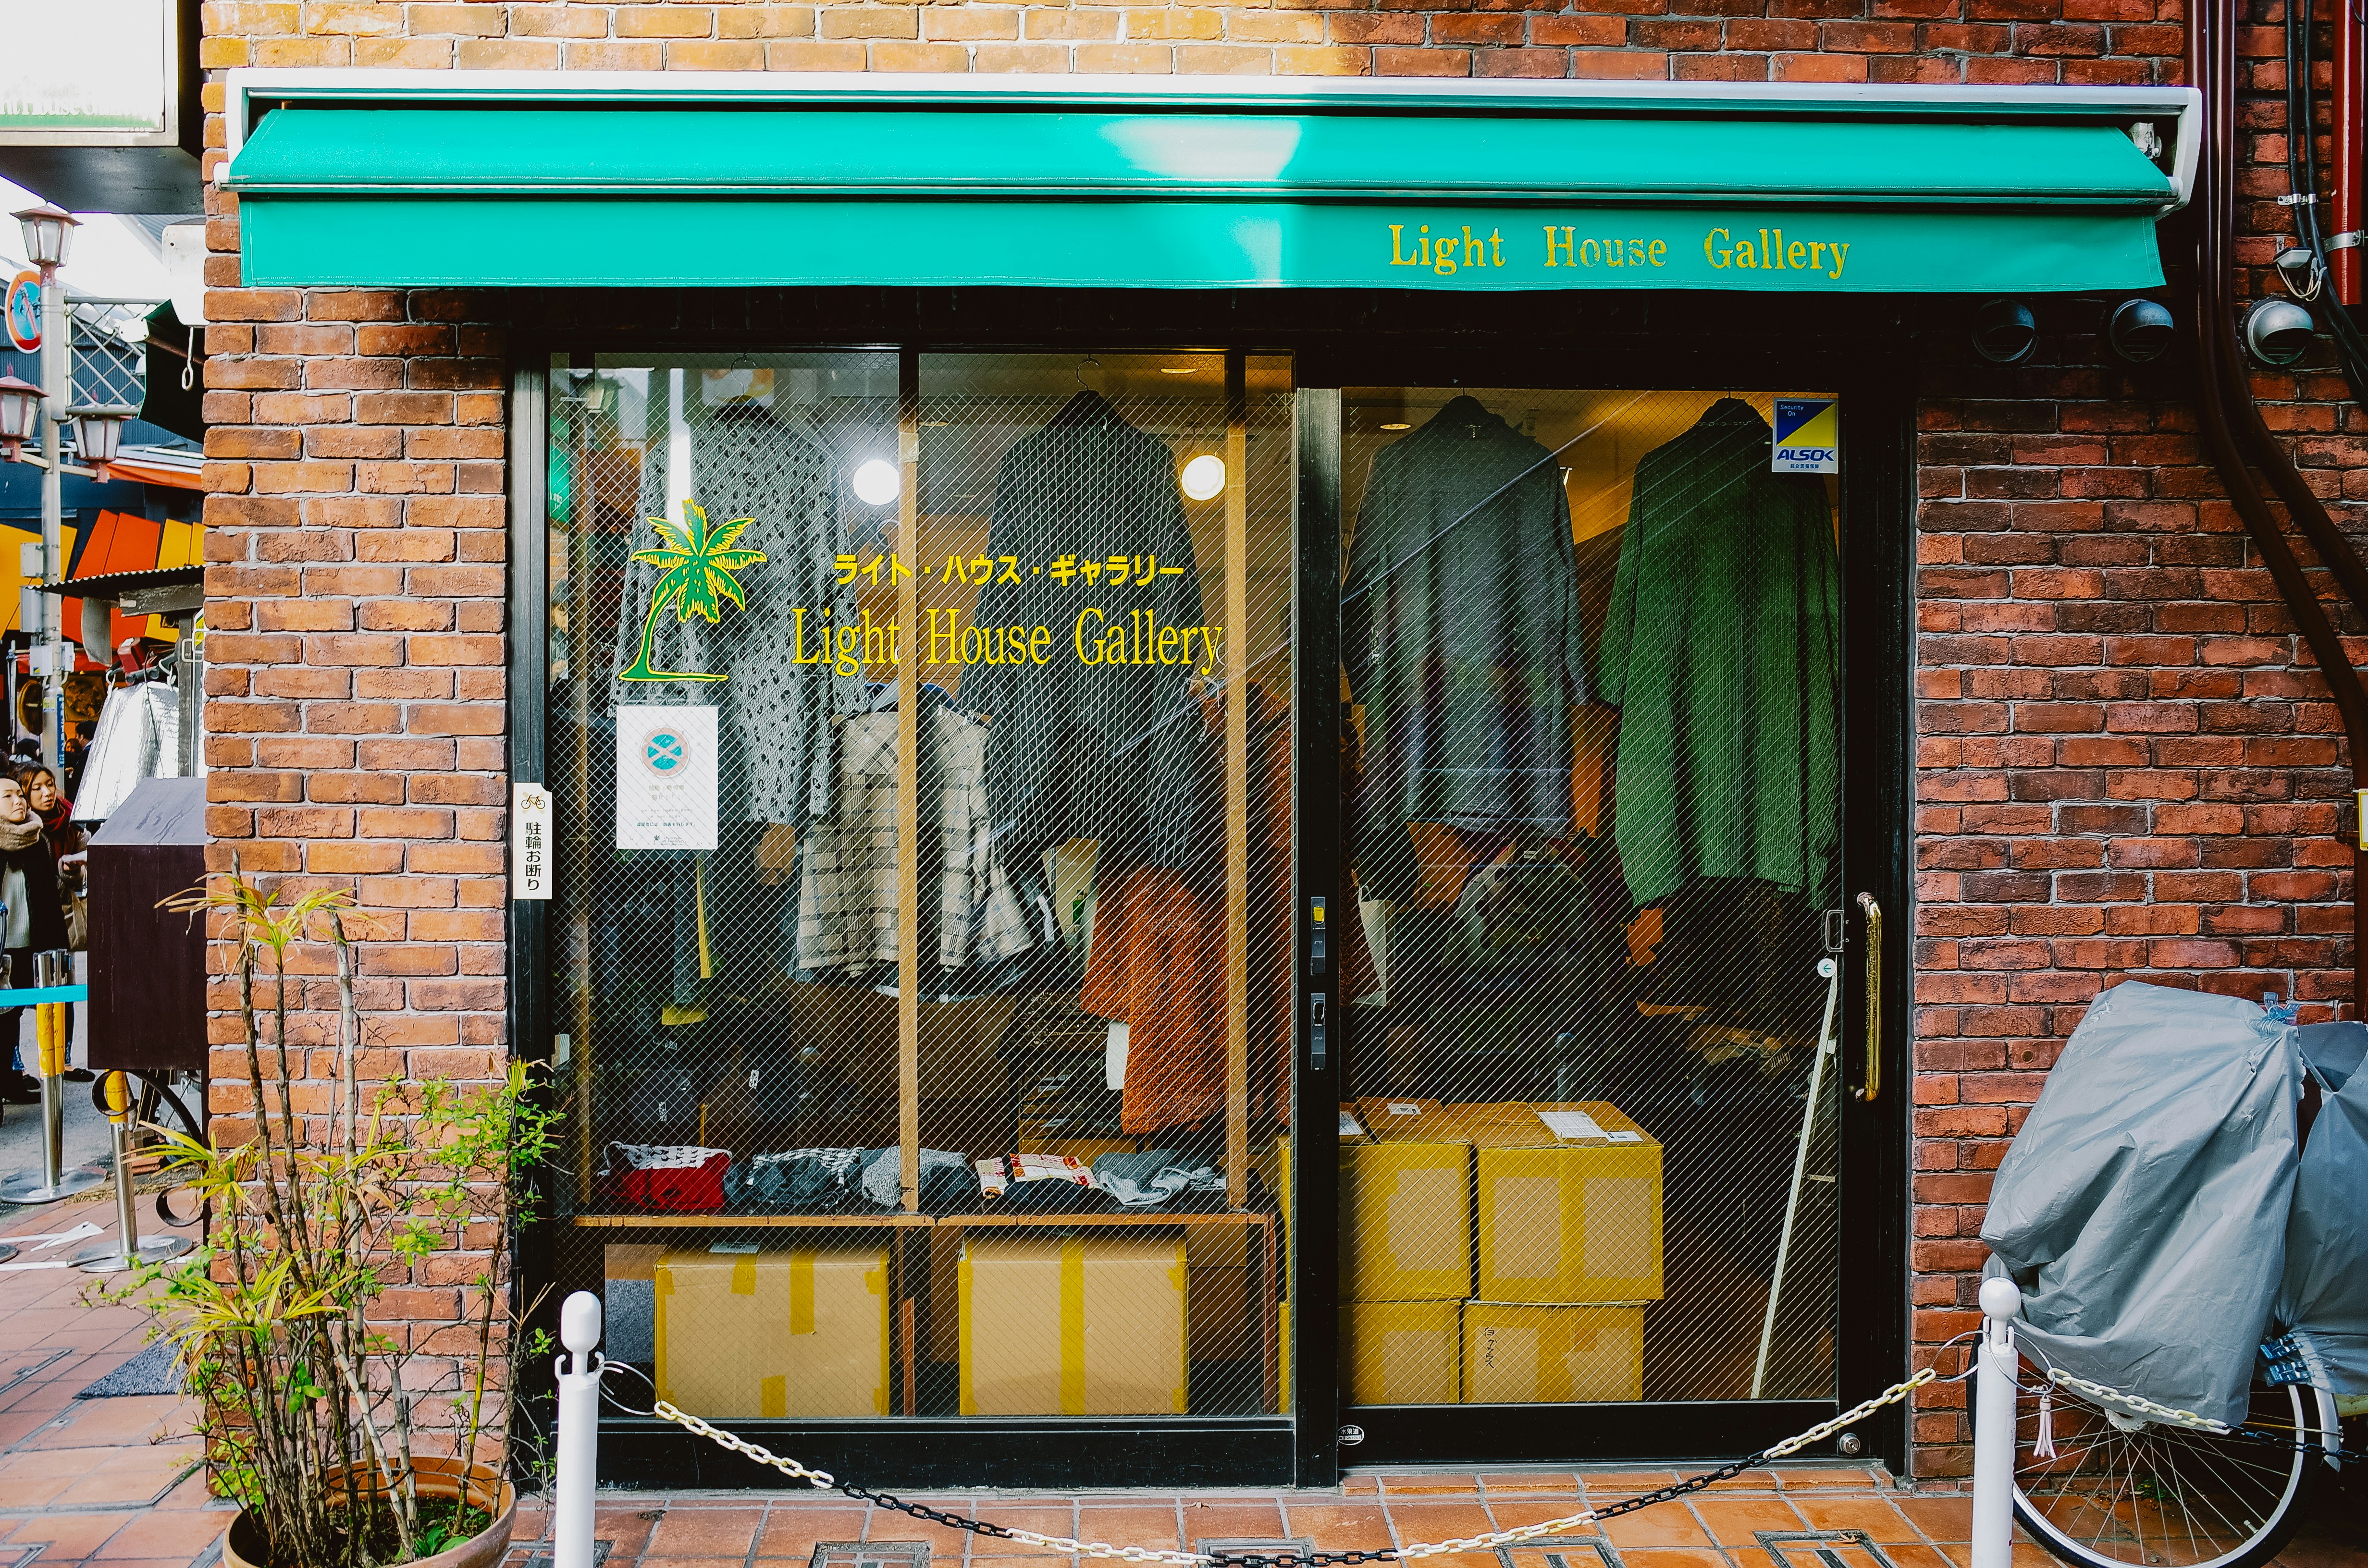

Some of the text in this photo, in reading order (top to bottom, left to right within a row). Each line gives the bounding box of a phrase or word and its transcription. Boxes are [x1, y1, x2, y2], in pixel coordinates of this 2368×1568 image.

[1388, 224, 1850, 280] Light House Gallery
[1776, 449, 1835, 462] ALSOK
[834, 553, 1184, 587] ライト・ハウス・ギャラリー
[791, 607, 1223, 676] Light House Gallery
[525, 822, 542, 891] 駐輪お断り
